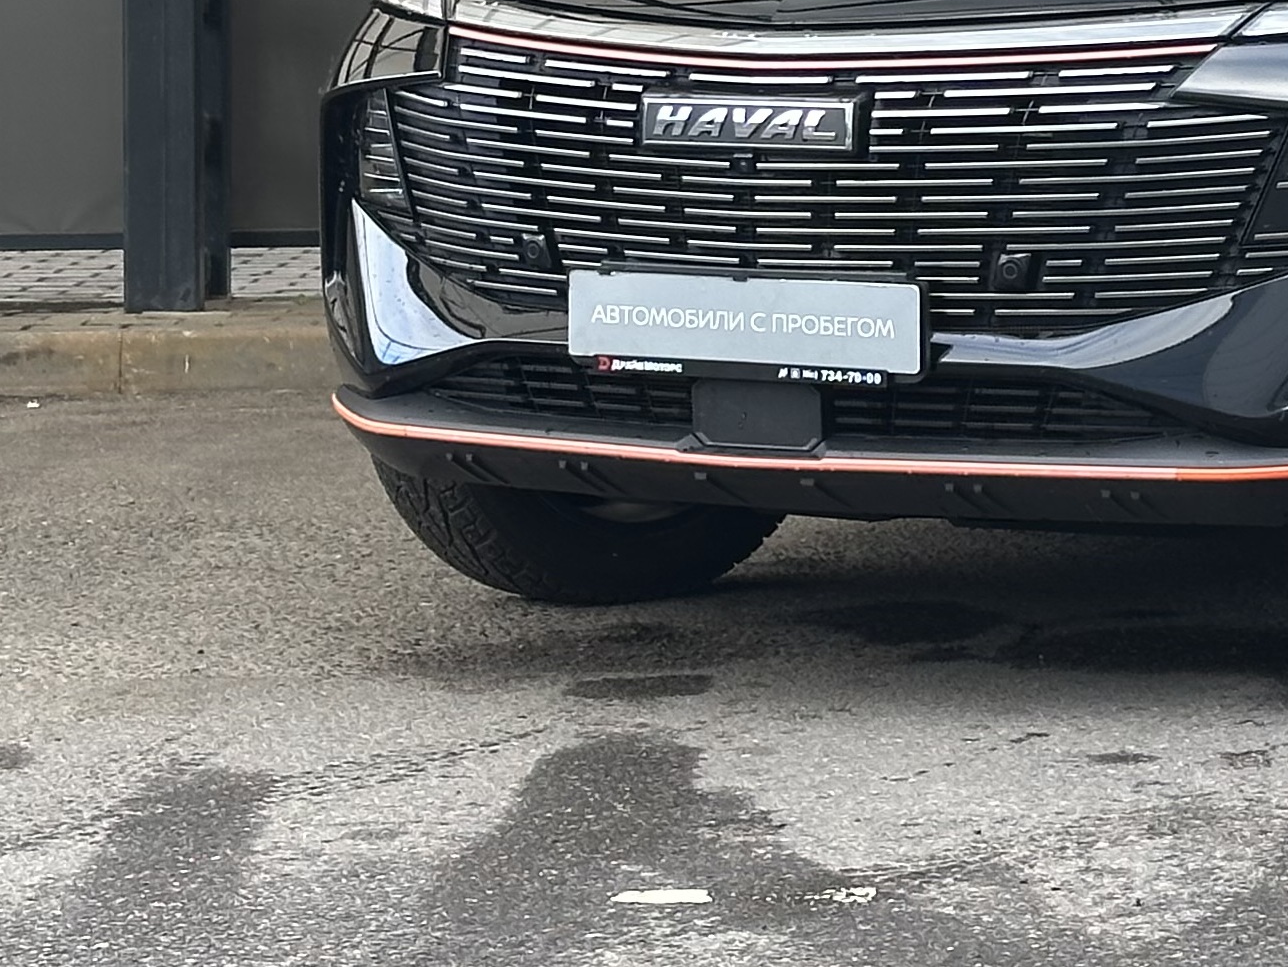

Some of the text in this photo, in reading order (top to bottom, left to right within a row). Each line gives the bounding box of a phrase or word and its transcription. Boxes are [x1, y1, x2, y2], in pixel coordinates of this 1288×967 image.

[652, 105, 836, 140] HAVAL
[591, 304, 895, 339] АВТОМОБИЛИ С ПРОБЕГОМ
